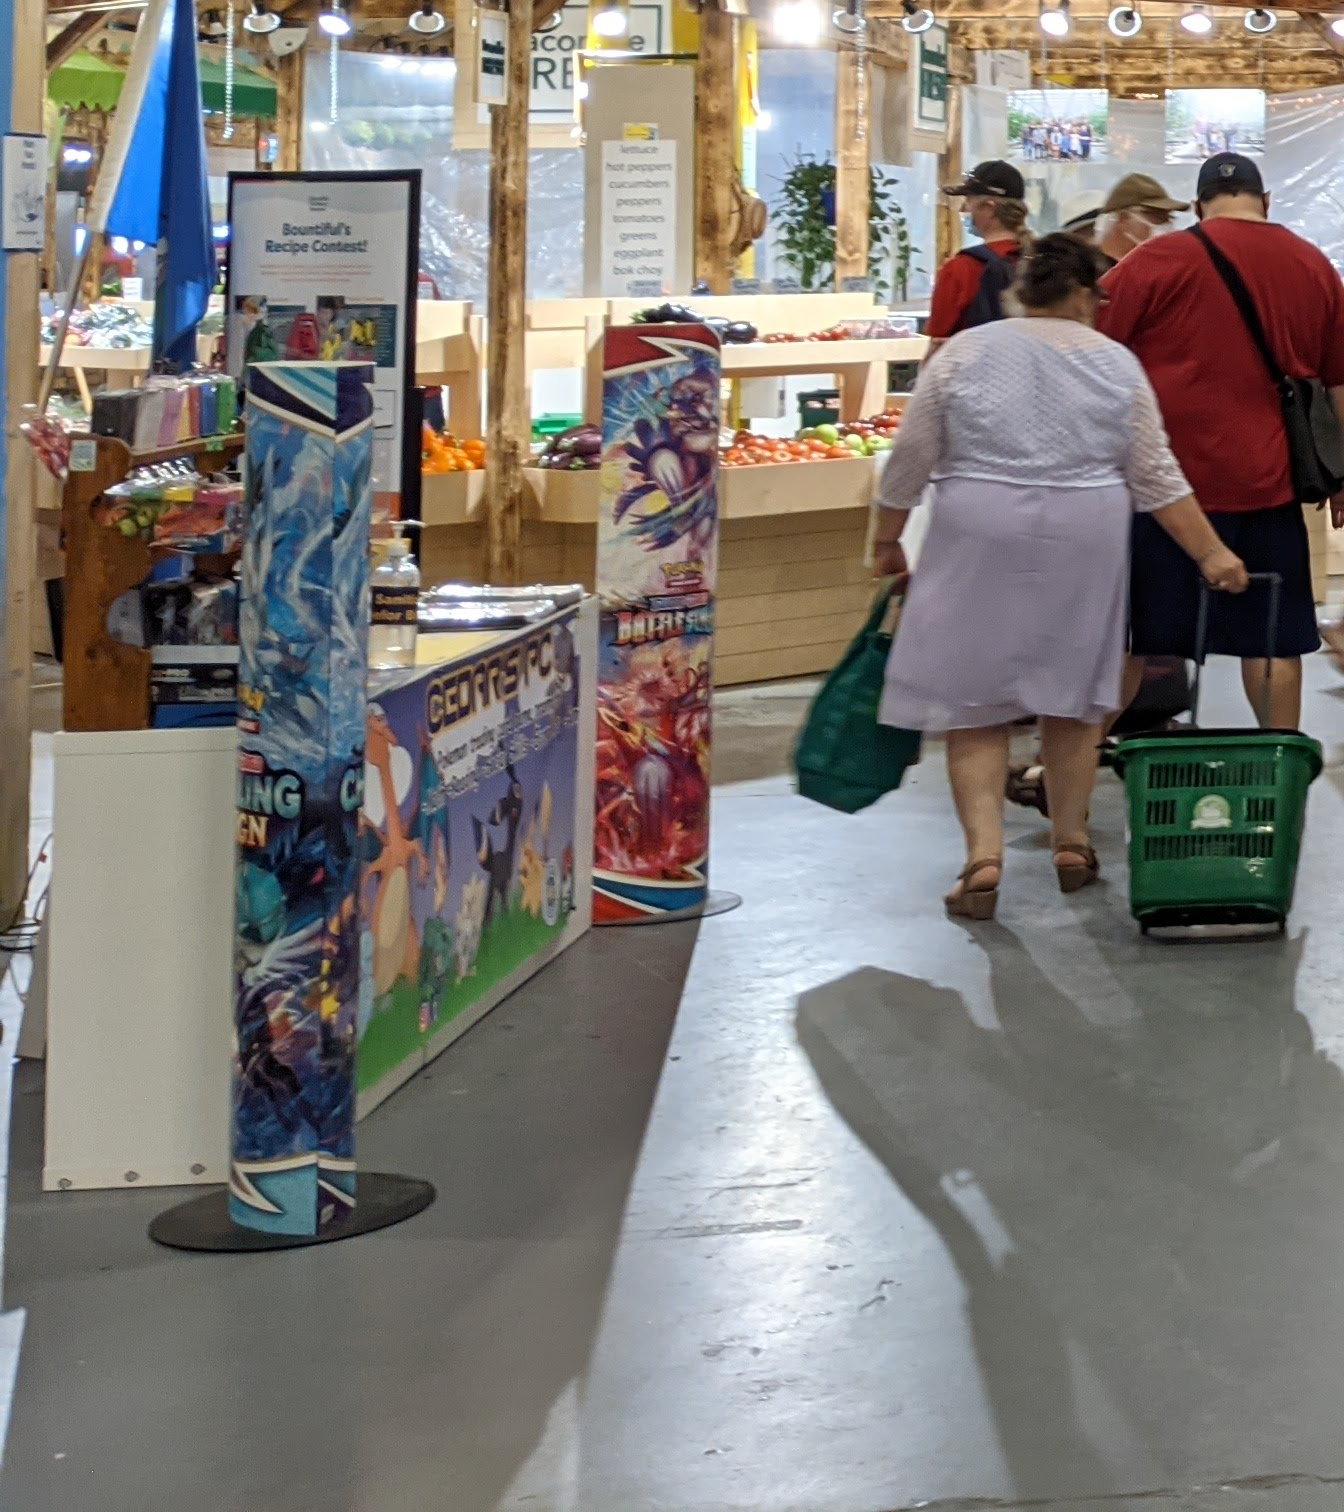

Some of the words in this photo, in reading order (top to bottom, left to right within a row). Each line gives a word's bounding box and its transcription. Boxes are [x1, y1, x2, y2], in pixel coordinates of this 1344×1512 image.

[620, 144, 658, 154] lettuce
[606, 162, 625, 171] hot
[627, 163, 672, 173] peppers
[609, 179, 669, 189] cucumbers
[616, 197, 662, 208] peppers
[613, 214, 665, 223] tomatoes
[282, 222, 352, 236] Bountiful's
[620, 232, 657, 242] greens
[265, 239, 309, 255] Recipe
[312, 239, 368, 253] Contest!
[614, 248, 665, 260] eggplant
[613, 266, 634, 276] bok
[636, 265, 664, 277] choy
[427, 643, 521, 737] CEDARS
